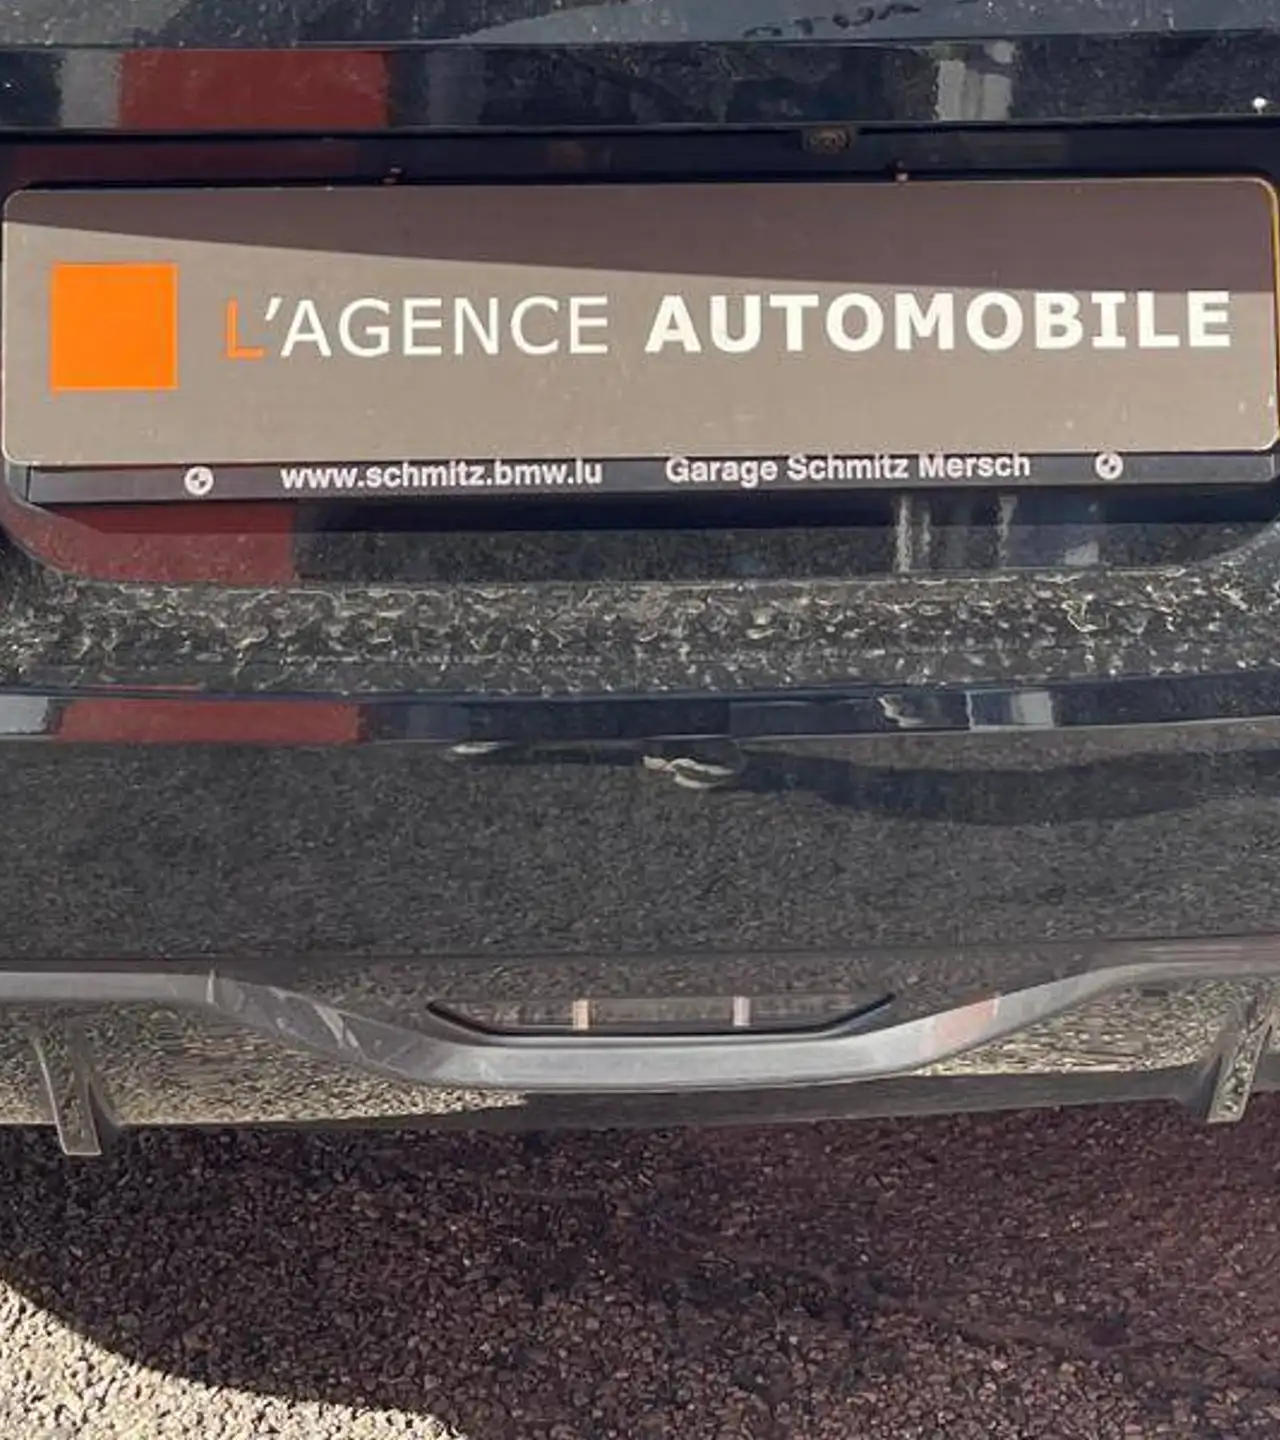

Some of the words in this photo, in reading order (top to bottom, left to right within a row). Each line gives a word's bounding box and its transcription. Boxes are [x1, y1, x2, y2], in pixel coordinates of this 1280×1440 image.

[226, 295, 609, 358] L'AGENCE
[644, 291, 1232, 353] AUTOMOBILE
[280, 458, 603, 490] www.schmitz.bmw.lu
[664, 455, 778, 488] Garage
[786, 453, 910, 482] Schmitz
[918, 451, 1032, 479] Mersch
